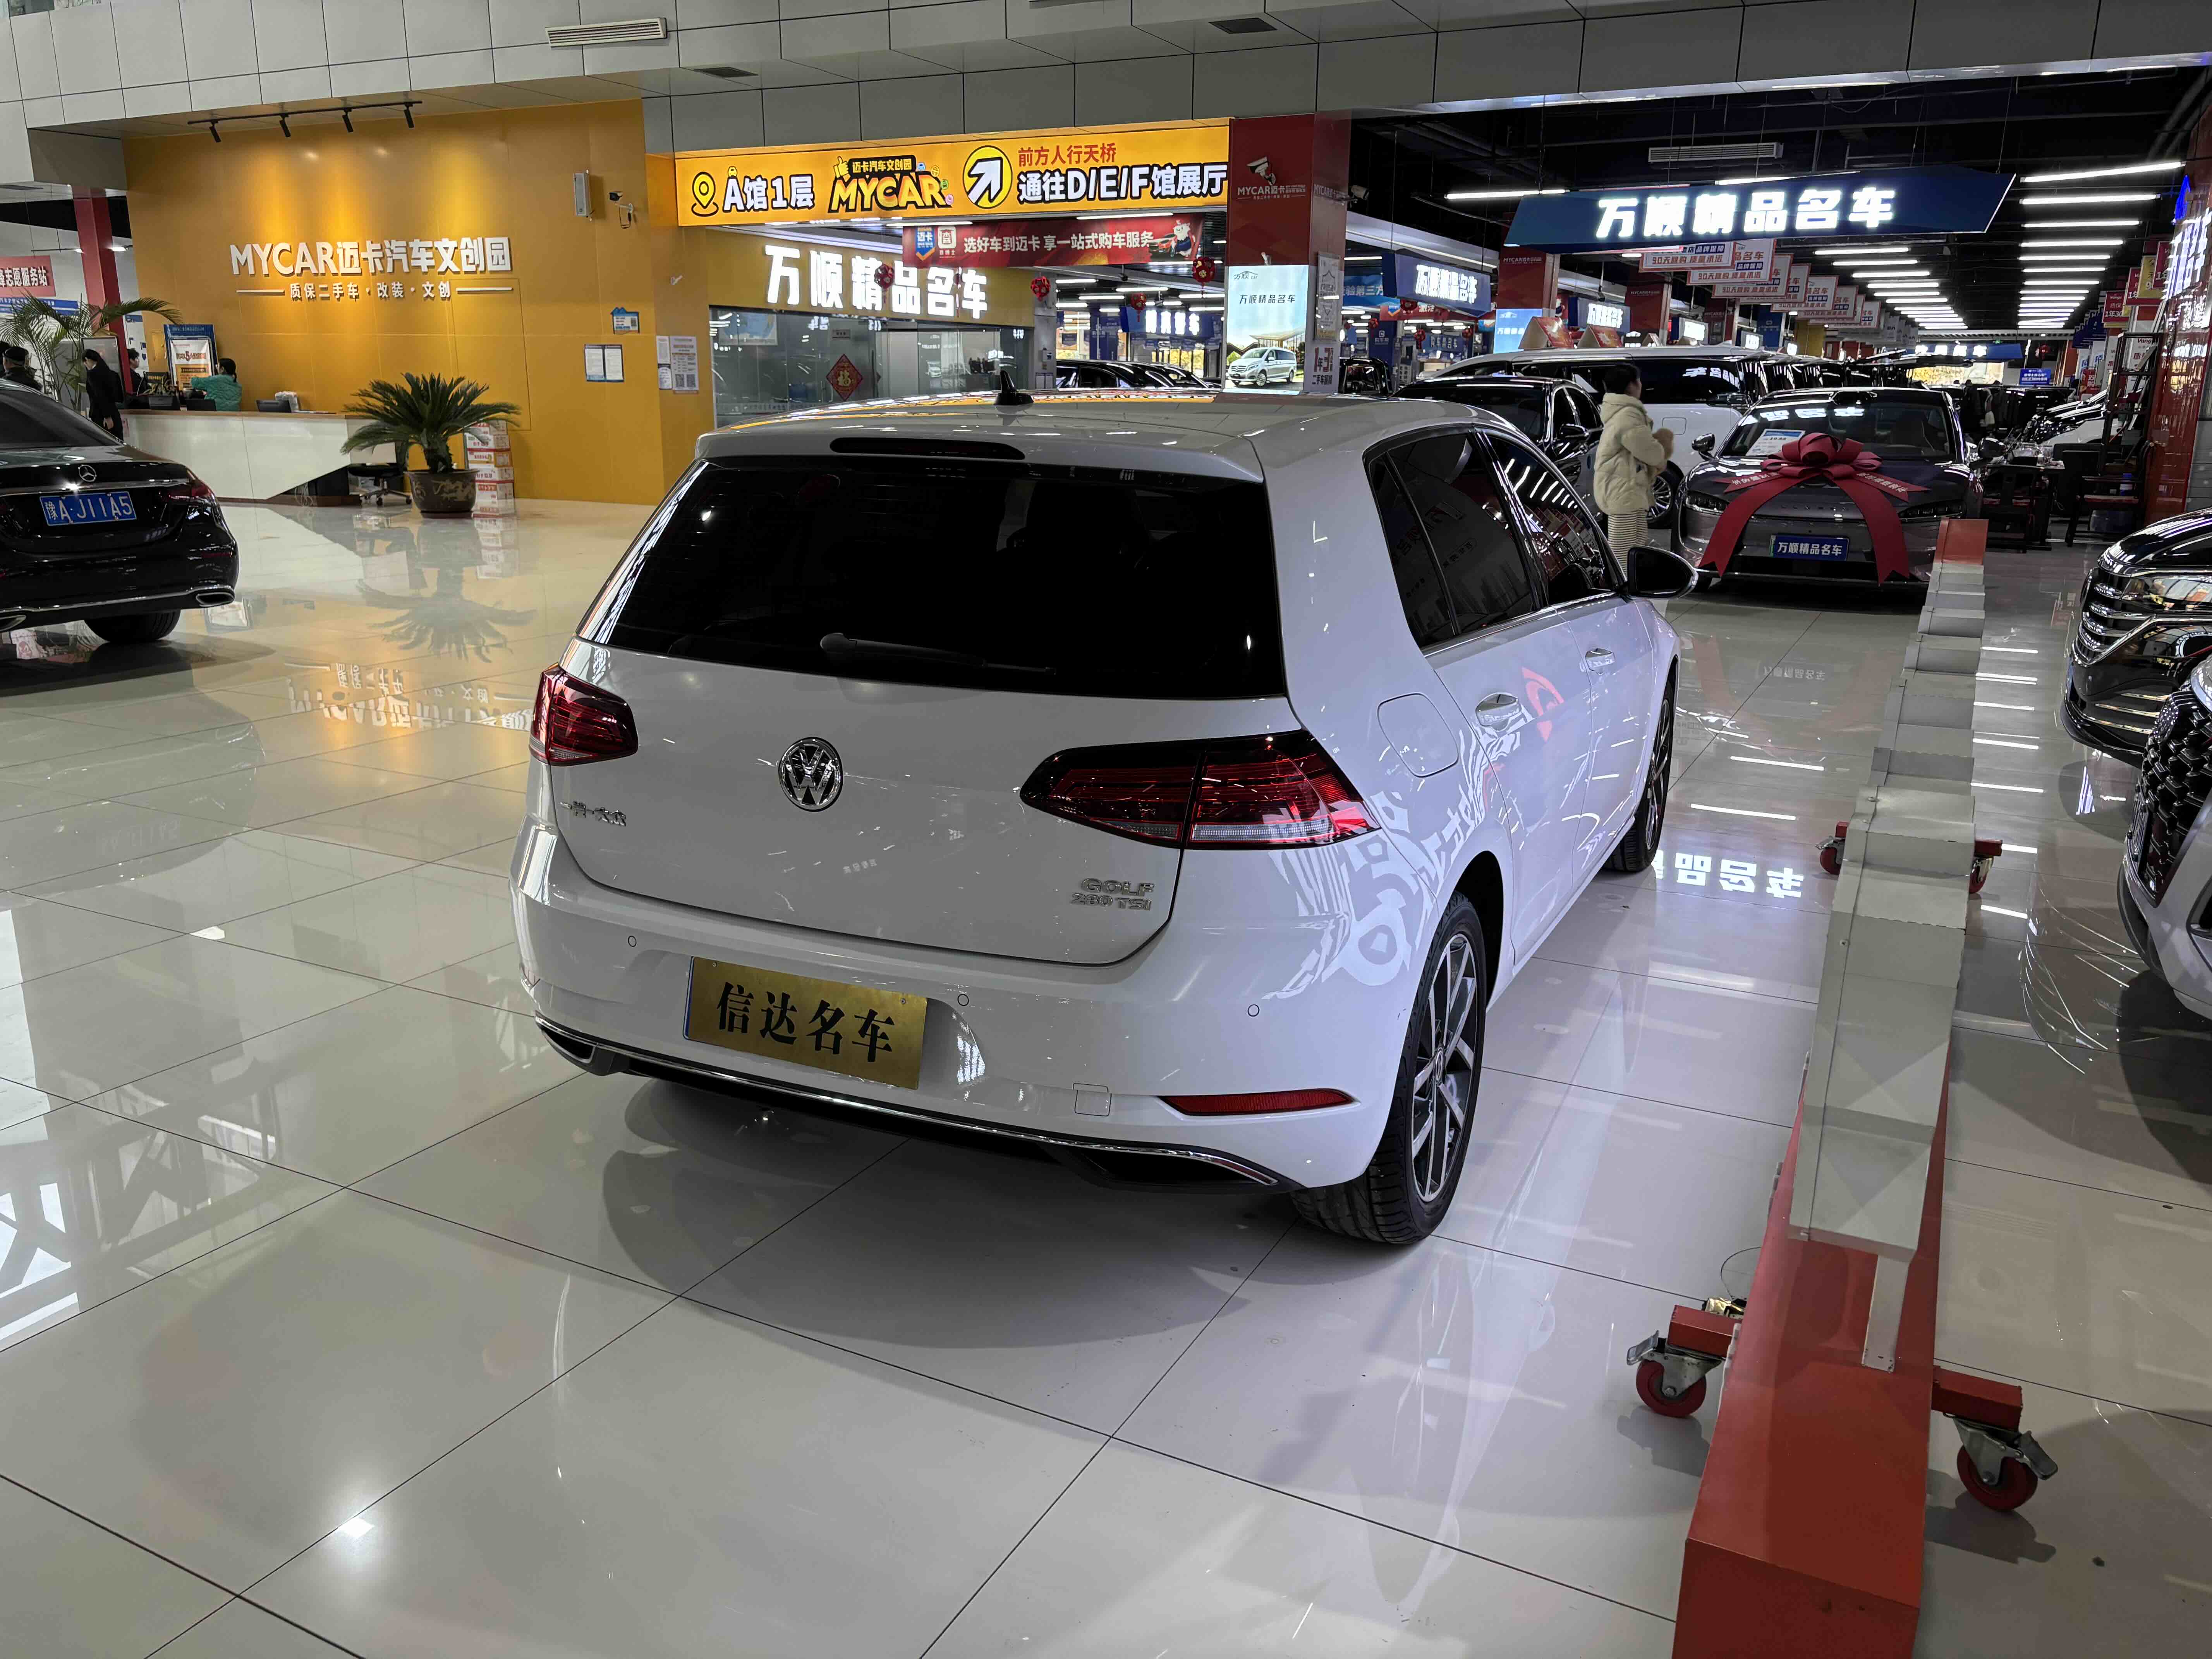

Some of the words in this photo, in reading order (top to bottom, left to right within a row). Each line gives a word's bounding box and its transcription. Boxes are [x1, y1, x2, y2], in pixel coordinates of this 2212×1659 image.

[852, 159, 912, 173] 迈卡汽车文创园
[1018, 142, 1117, 167] 前方人行天桥
[723, 174, 815, 212] A馆1层
[829, 173, 949, 212] MYCAR
[1018, 163, 1228, 203] 通往D/E/F馆展厅
[1595, 187, 1895, 238] 万顺精品名车
[963, 235, 1041, 253] 选好车到迈卡
[1043, 230, 1153, 252] 享一站式购车服务
[230, 237, 511, 275] MYCAR迈卡汽车文创园
[764, 245, 988, 319] 万顺精品名车
[1239, 294, 1295, 304] 万顺精品名车
[838, 369, 852, 387] 福
[1777, 542, 1843, 556] 万顺精品名车
[1081, 878, 1155, 896] GOLF
[1070, 893, 1113, 907] 280
[1117, 897, 1152, 911] TSI
[717, 982, 895, 1062] 信达名车
